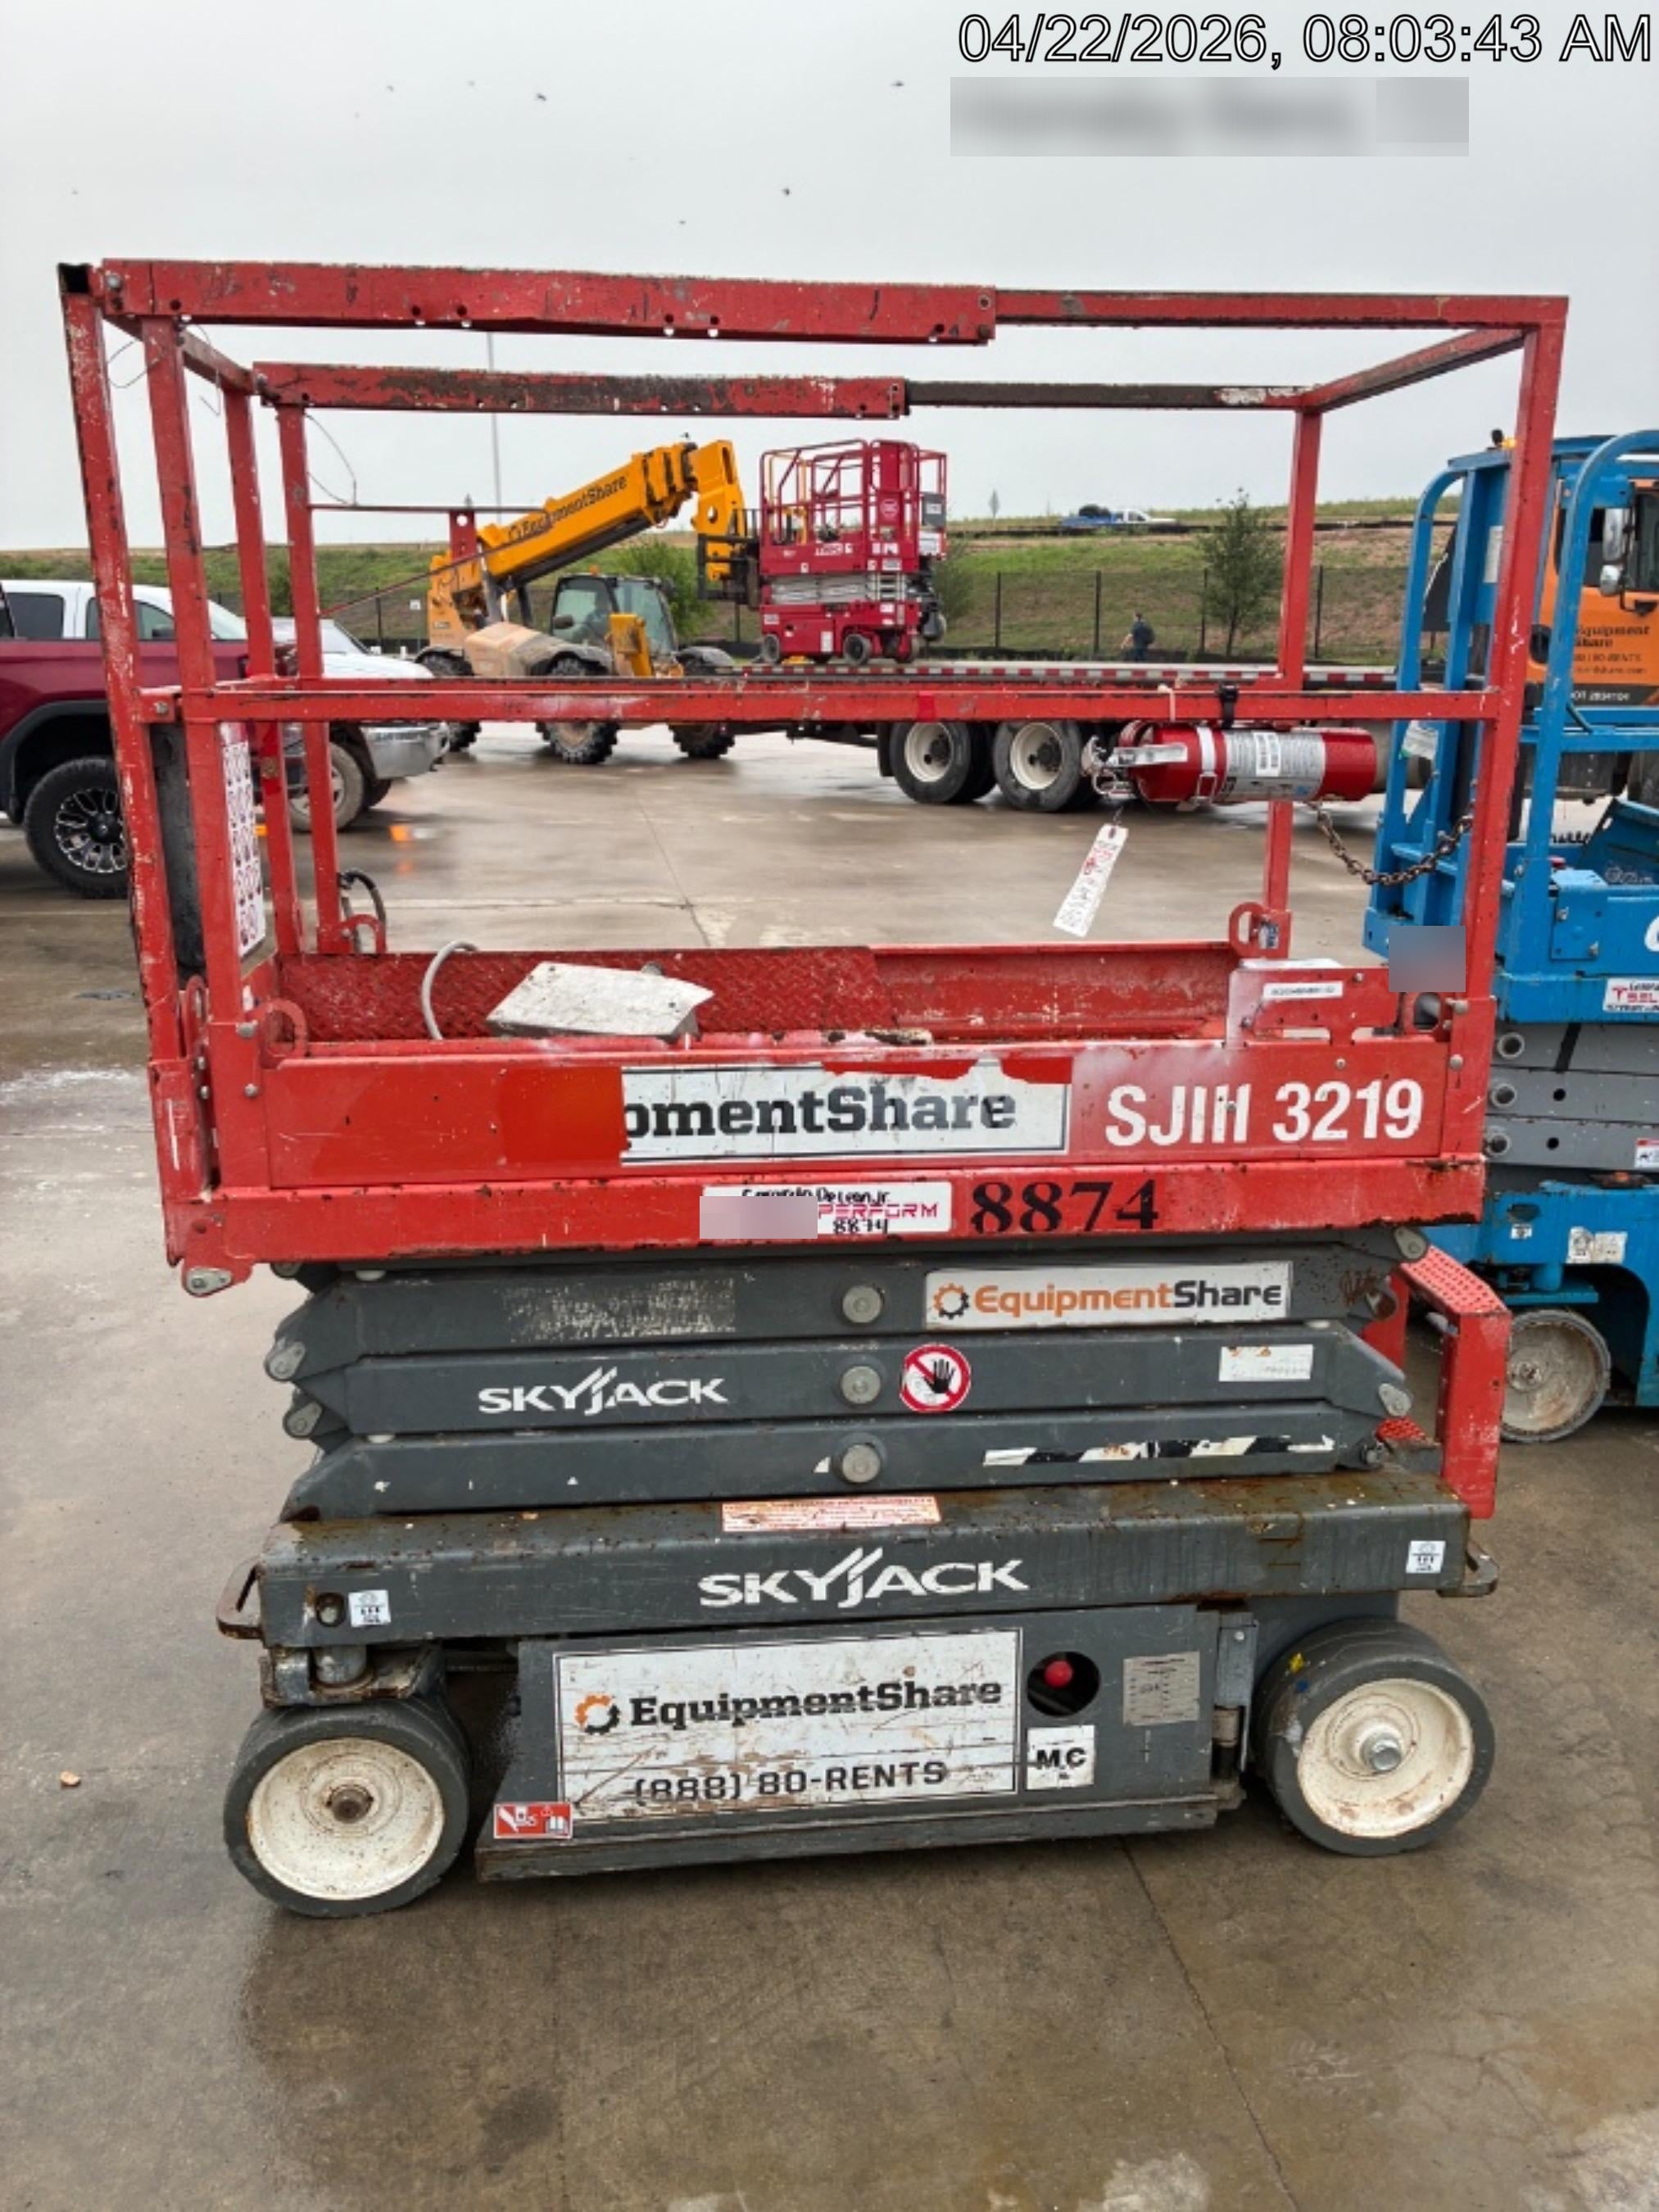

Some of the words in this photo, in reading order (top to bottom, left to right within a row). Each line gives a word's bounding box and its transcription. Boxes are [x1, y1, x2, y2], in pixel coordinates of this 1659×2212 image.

[1272, 1079, 1423, 1142] 3219
[818, 1203, 938, 1220] PERFORM
[970, 1179, 1158, 1232] 8874
[974, 1280, 1283, 1317] EquipmentShare
[478, 1367, 728, 1415] SKYJACK
[698, 1548, 1029, 1608] SKYJACK
[630, 1680, 1002, 1730] EquipmentShare
[635, 1772, 741, 1806] (888)
[759, 1761, 946, 1795] 80-RENTS
